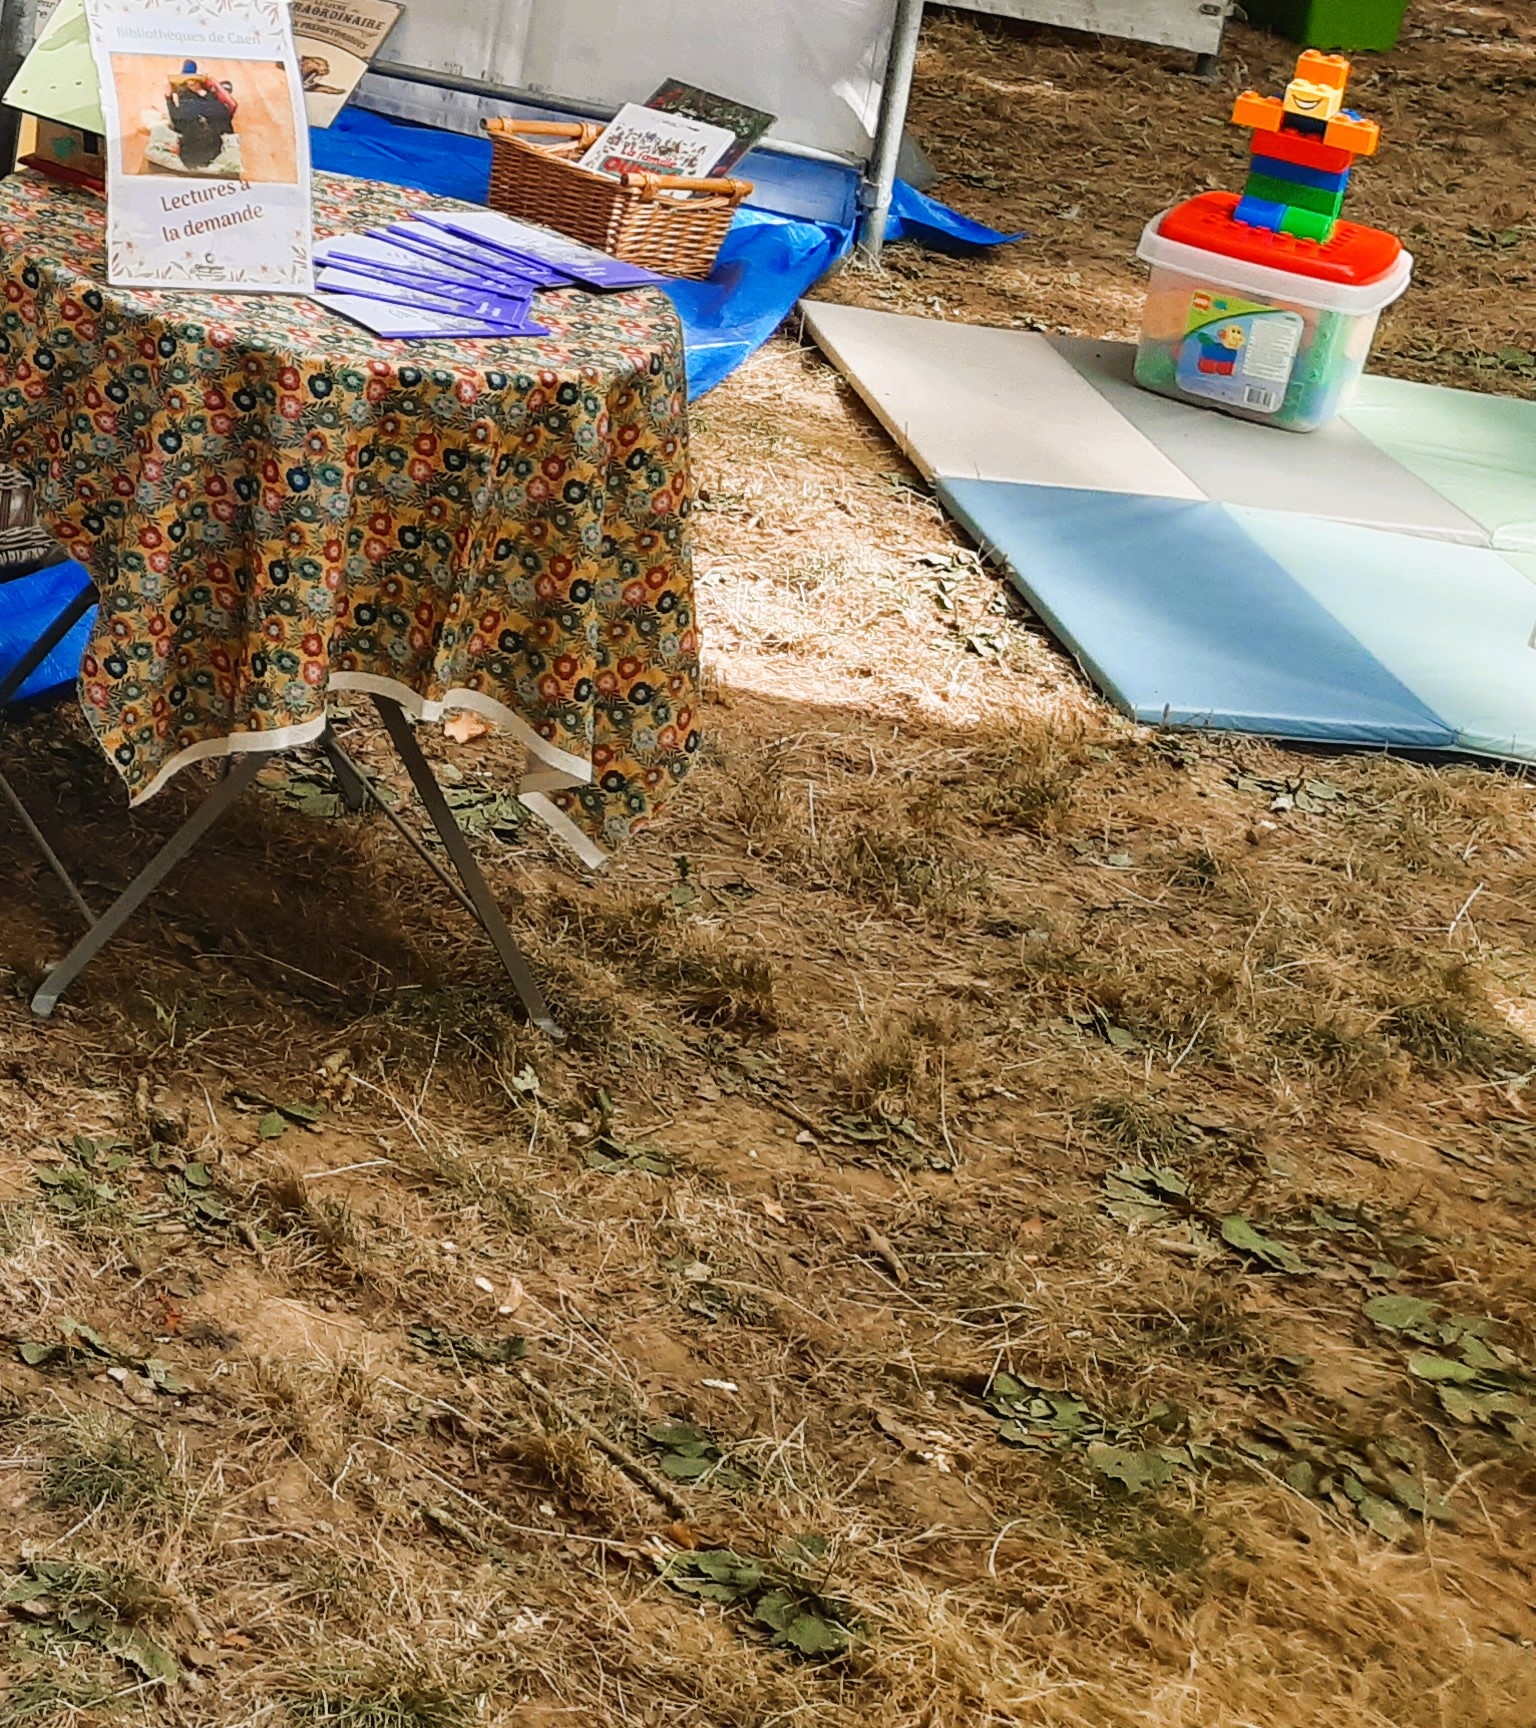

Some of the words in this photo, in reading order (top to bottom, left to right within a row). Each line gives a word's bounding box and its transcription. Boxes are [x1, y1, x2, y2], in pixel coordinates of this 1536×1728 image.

[116, 25, 207, 43] Bibliothèques
[208, 31, 225, 43] de
[228, 32, 262, 45] Caen
[160, 181, 237, 212] Lectures
[162, 226, 181, 243] la
[183, 204, 264, 238] demande
